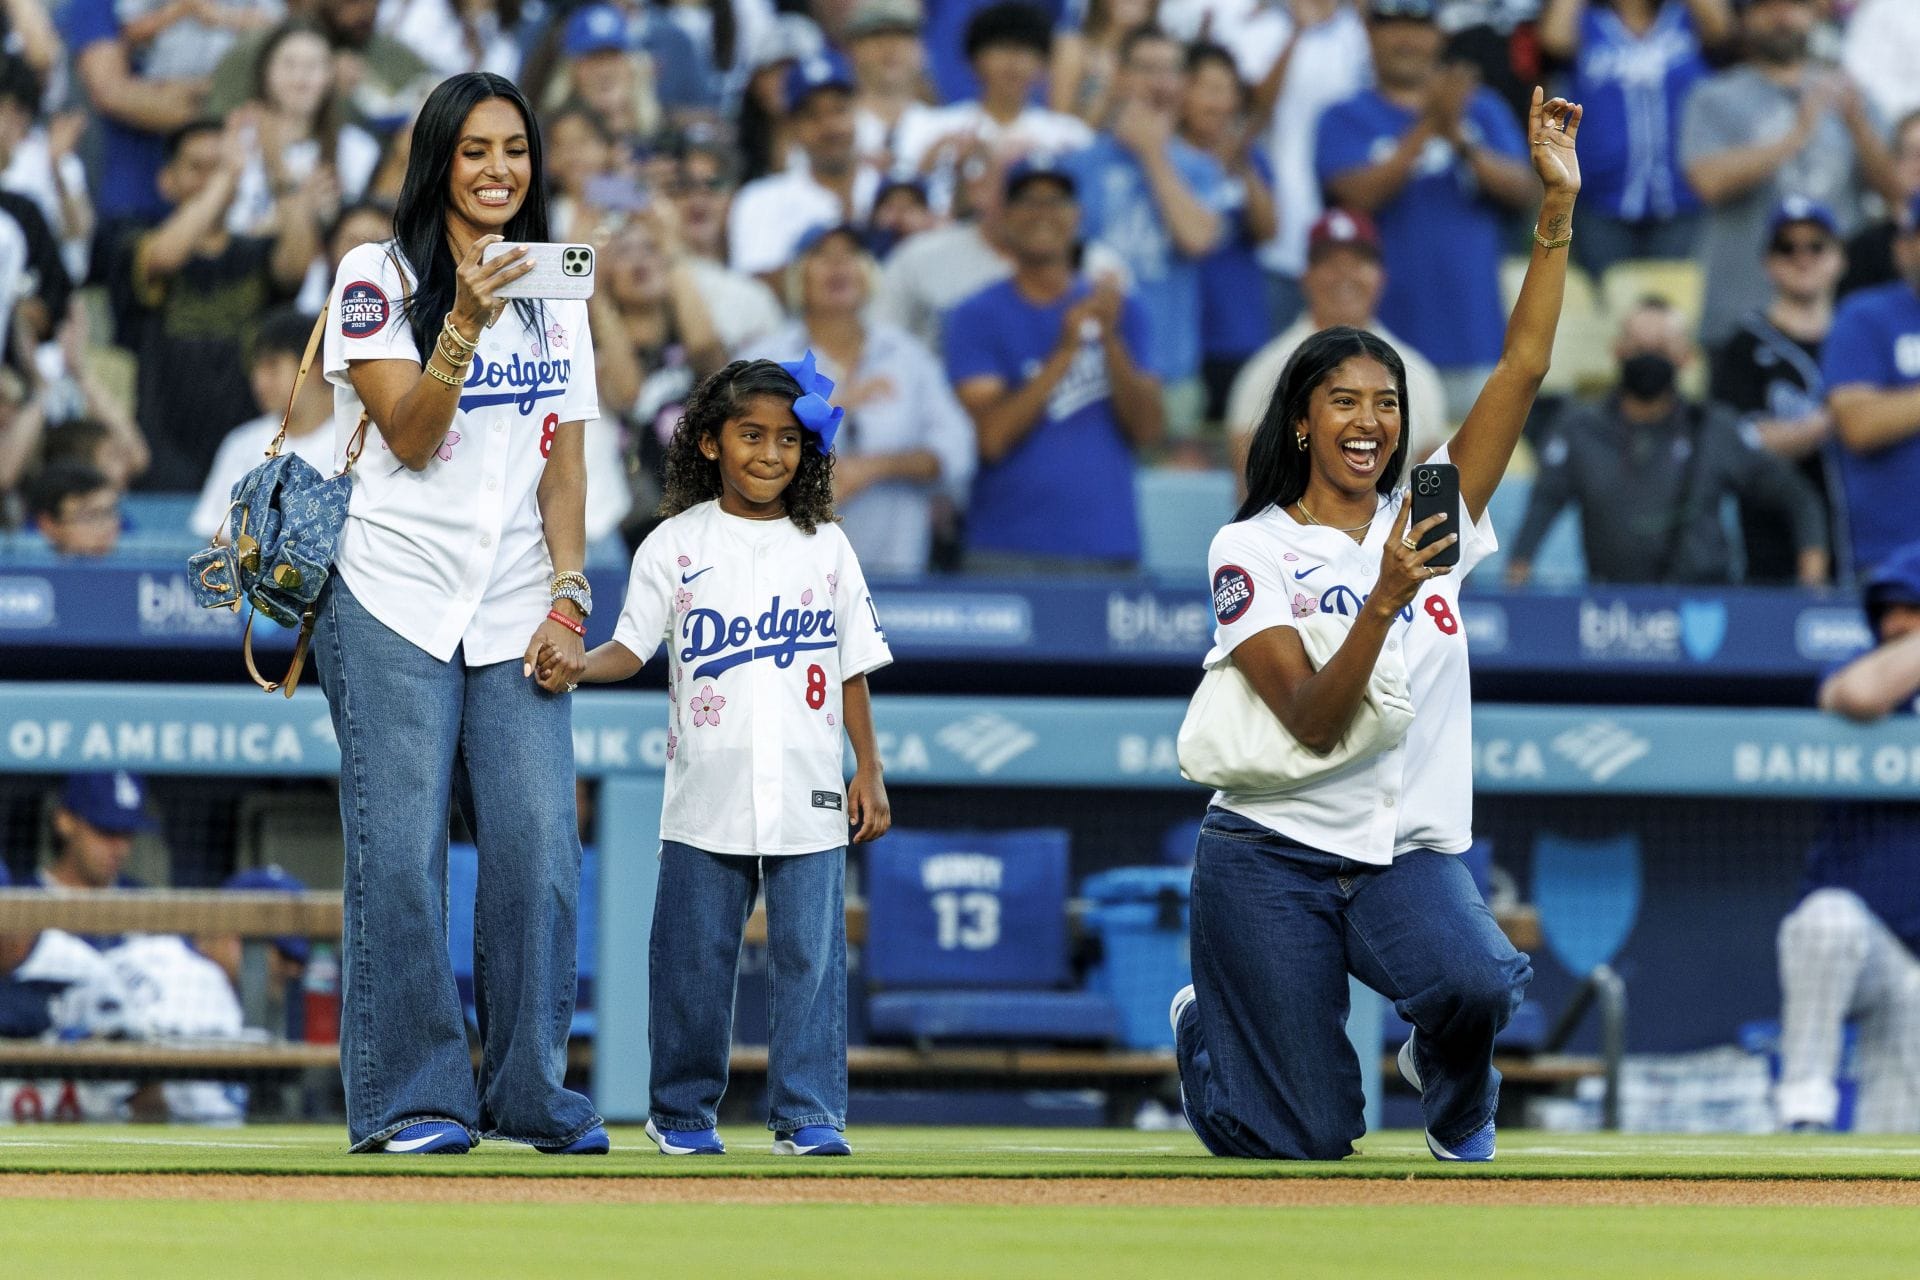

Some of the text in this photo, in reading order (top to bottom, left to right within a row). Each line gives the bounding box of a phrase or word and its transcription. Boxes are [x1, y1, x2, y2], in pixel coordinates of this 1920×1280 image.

[342, 303, 381, 314] TOKYO
[539, 412, 559, 459] 8
[1215, 581, 1245, 605] TOKYO
[1217, 589, 1249, 615] SERIES
[1226, 604, 1237, 614] 2025
[1107, 589, 1207, 641] blue
[1424, 594, 1458, 635] 8
[1579, 599, 1681, 649] blue
[805, 663, 827, 711] 8
[9, 719, 303, 763] OF AMERICA
[1118, 734, 1179, 774] BA
[1732, 742, 1863, 783] BANK
[932, 891, 1002, 951] 13
